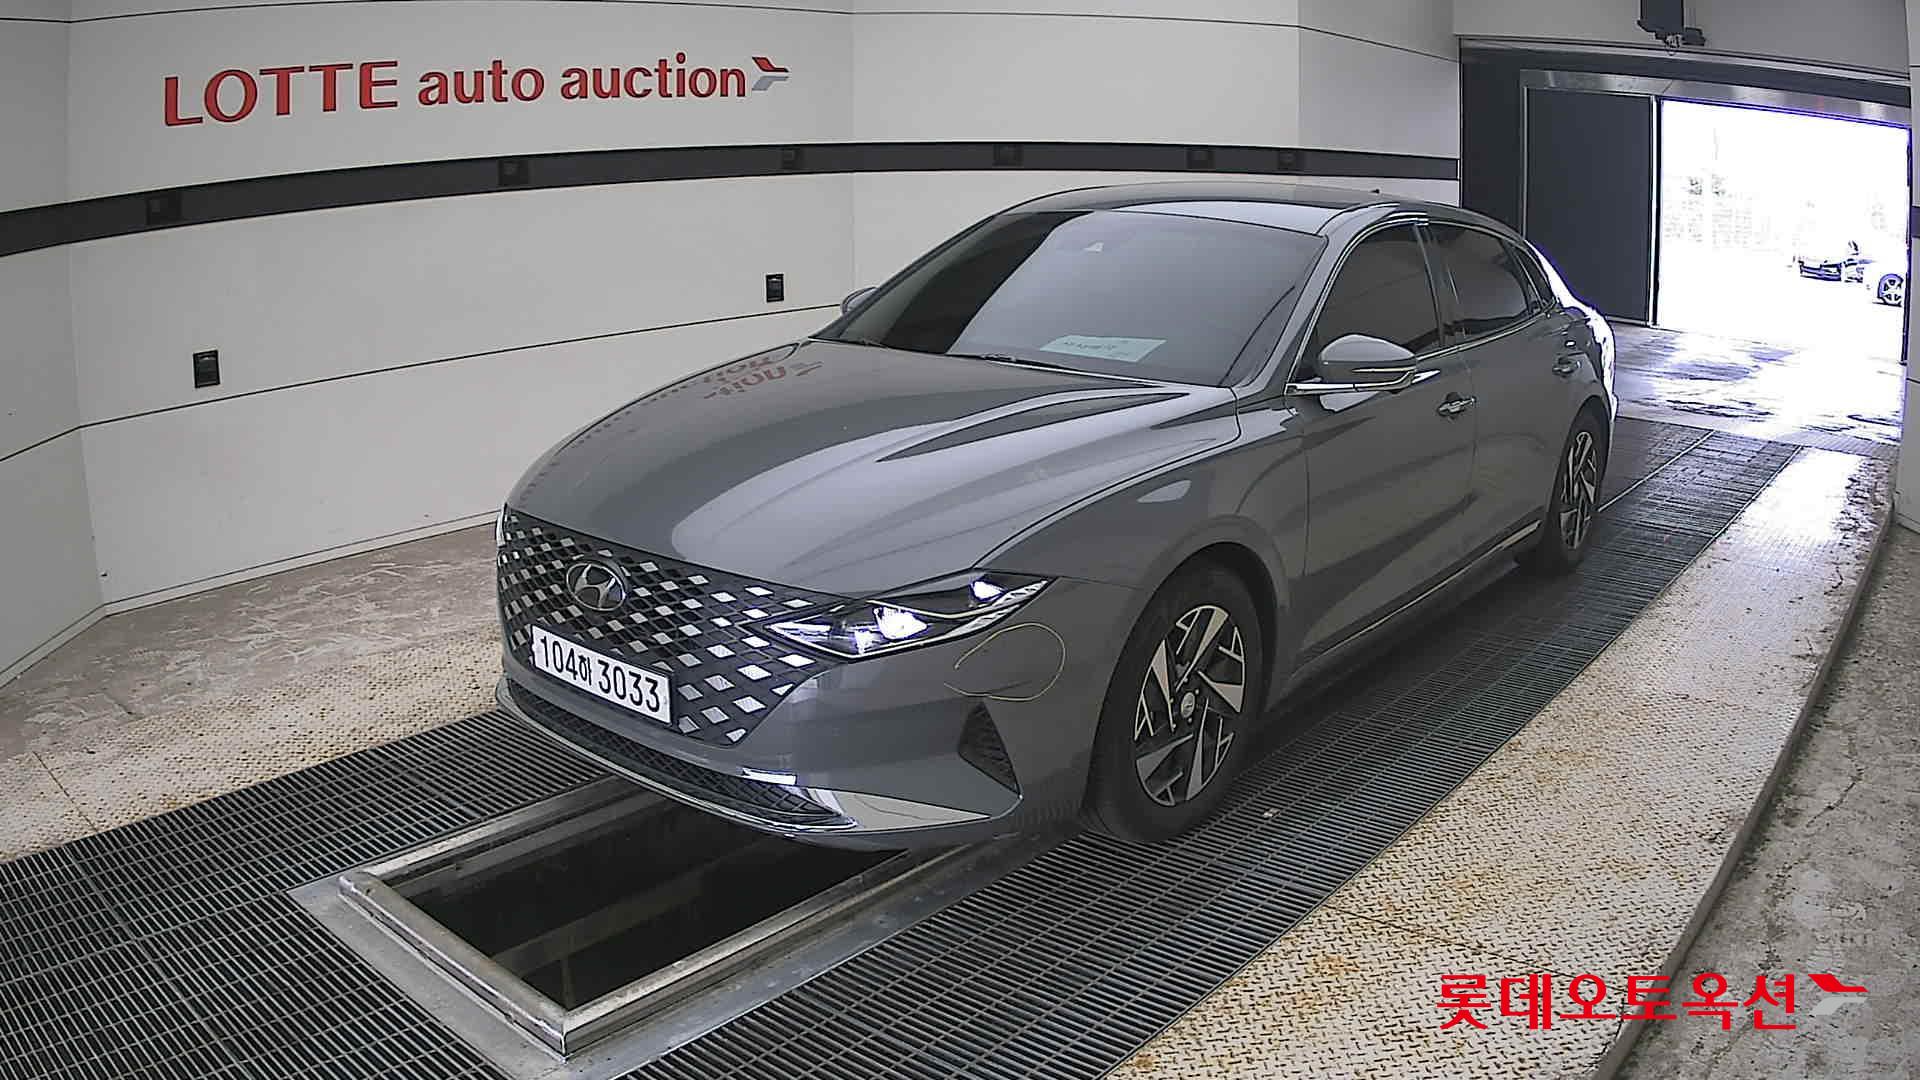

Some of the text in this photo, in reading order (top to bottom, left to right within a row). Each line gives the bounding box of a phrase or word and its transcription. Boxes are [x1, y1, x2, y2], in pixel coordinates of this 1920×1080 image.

[163, 52, 747, 127] LOTTE auto auction
